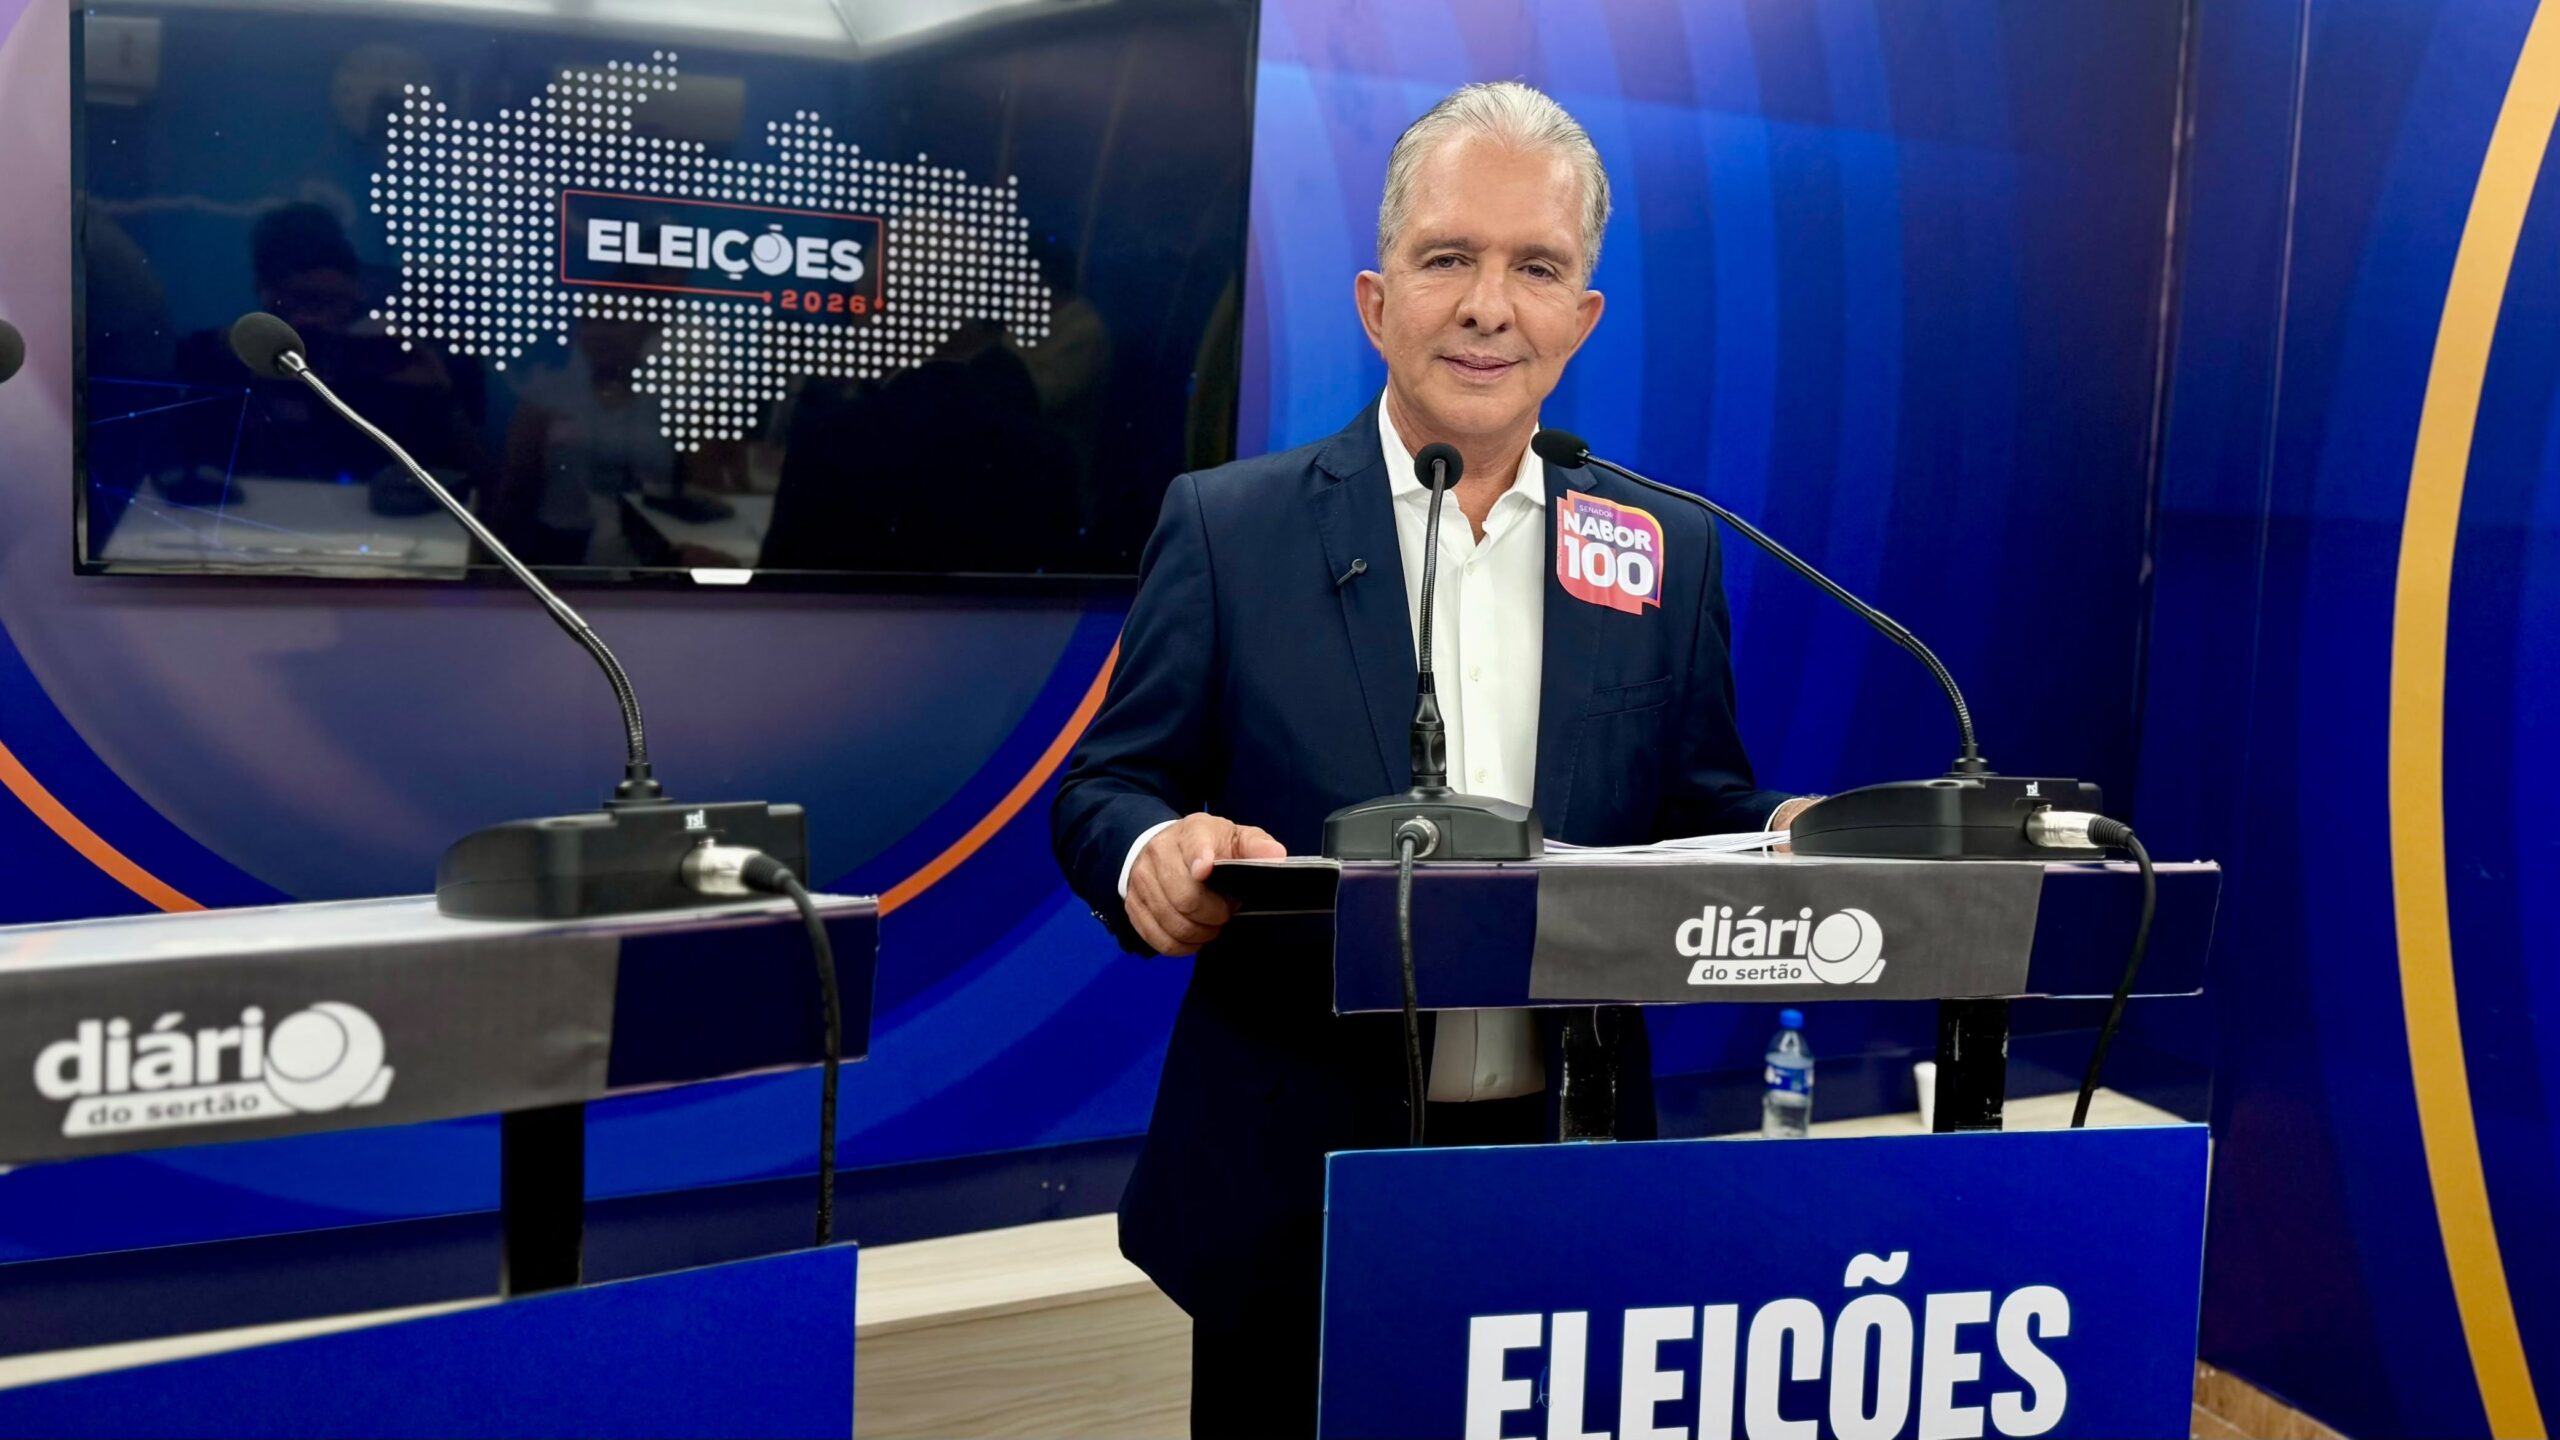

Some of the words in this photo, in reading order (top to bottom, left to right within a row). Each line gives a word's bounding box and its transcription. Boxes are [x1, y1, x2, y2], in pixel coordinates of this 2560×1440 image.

[586, 218, 865, 283] ELEIÇÕES
[780, 289, 867, 315] 2026
[1564, 511, 1653, 552] NABOR
[1564, 535, 1654, 596] 100
[1675, 905, 1883, 985] diário
[1702, 964, 1728, 980] do
[1735, 963, 1802, 980] sertão
[33, 1001, 386, 1113] diário
[87, 1104, 132, 1127] do
[145, 1093, 260, 1119] sertão
